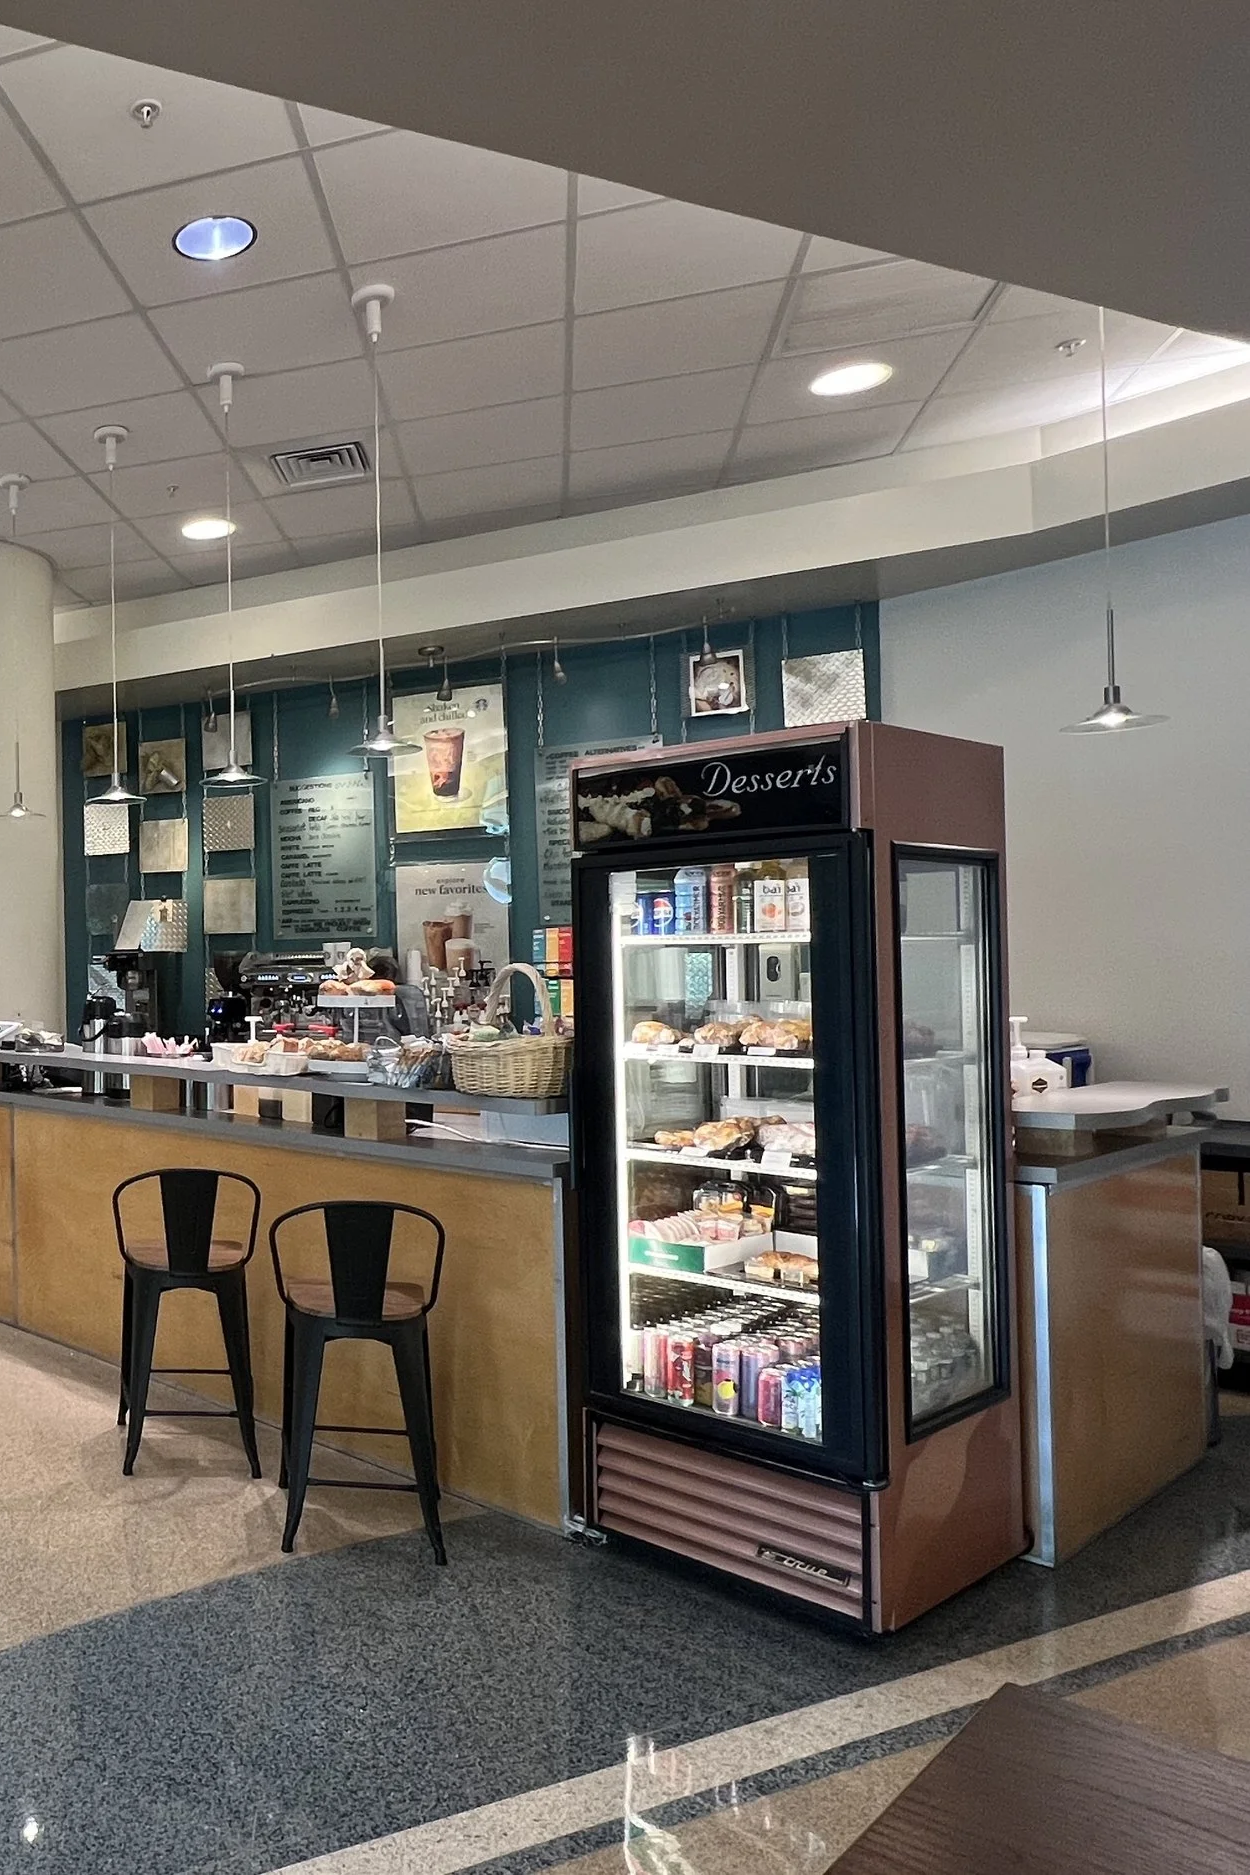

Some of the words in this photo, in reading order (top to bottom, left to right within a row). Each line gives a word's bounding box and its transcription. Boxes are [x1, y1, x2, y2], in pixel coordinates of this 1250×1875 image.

[419, 713, 437, 724] and
[701, 754, 837, 797] Desserts
[414, 887, 438, 896] new
[439, 884, 487, 895] favorites
[762, 882, 781, 894] bai
